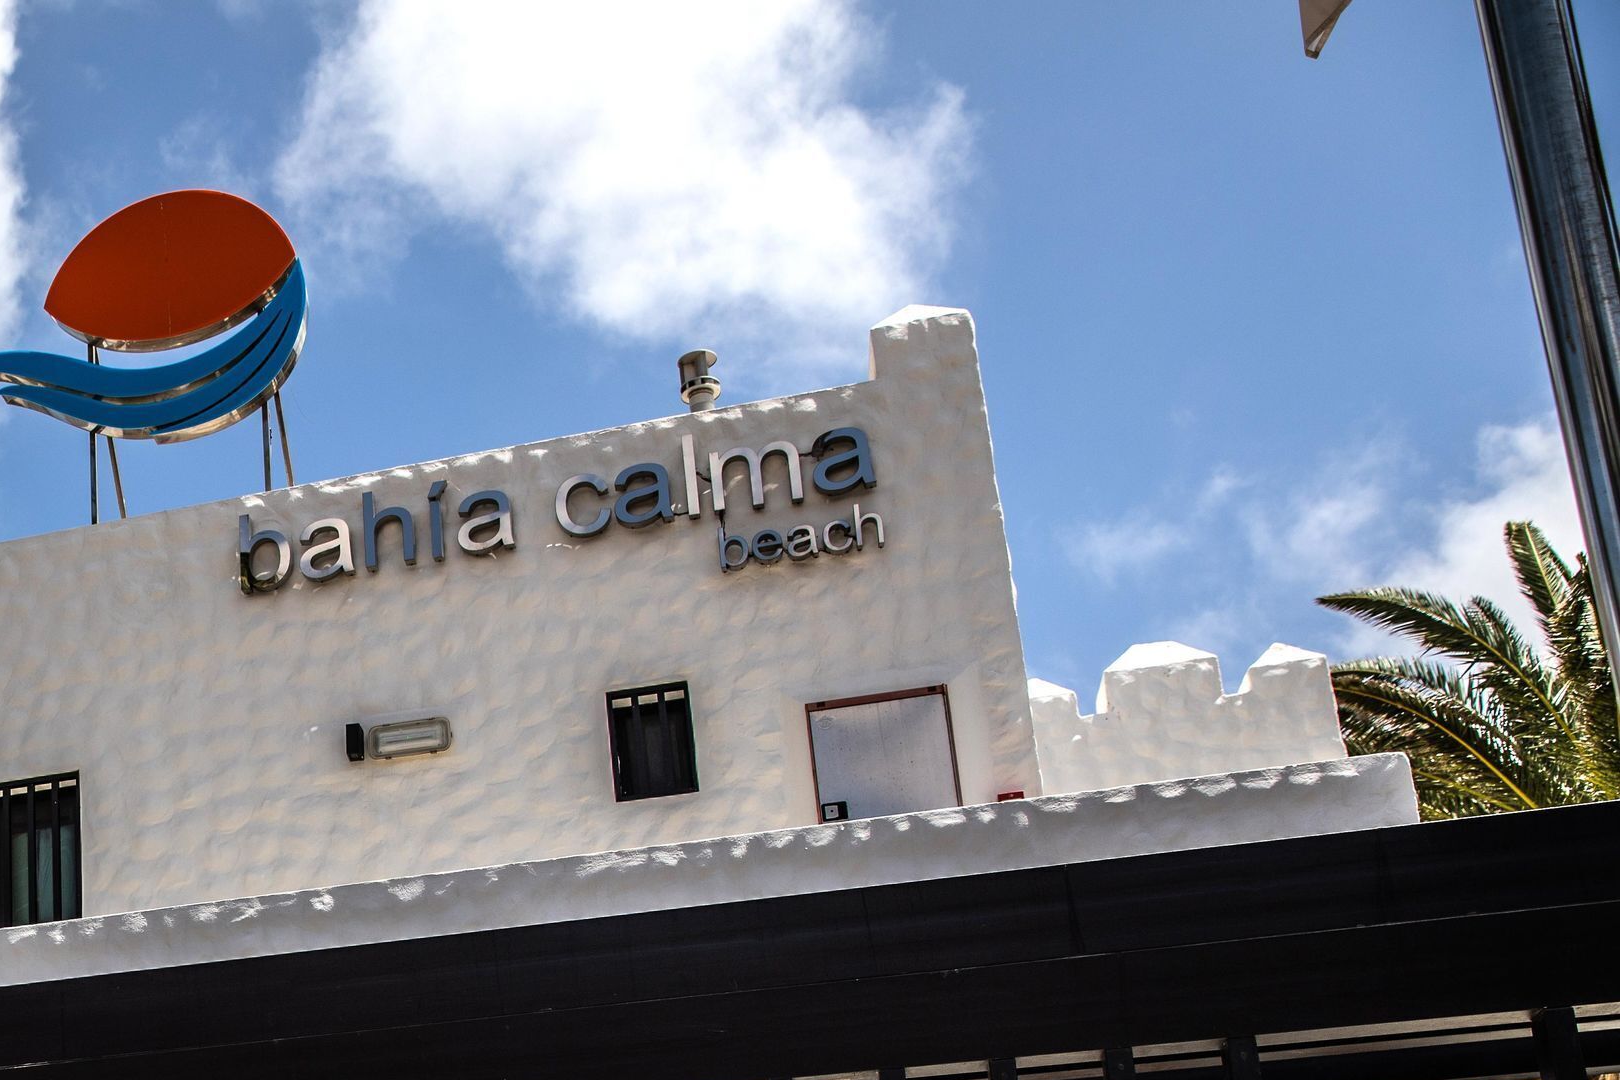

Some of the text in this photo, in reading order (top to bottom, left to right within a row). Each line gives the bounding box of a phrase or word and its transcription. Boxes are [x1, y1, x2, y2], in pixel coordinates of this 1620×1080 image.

[238, 426, 878, 595] bahía calma
[716, 503, 886, 573] beach
